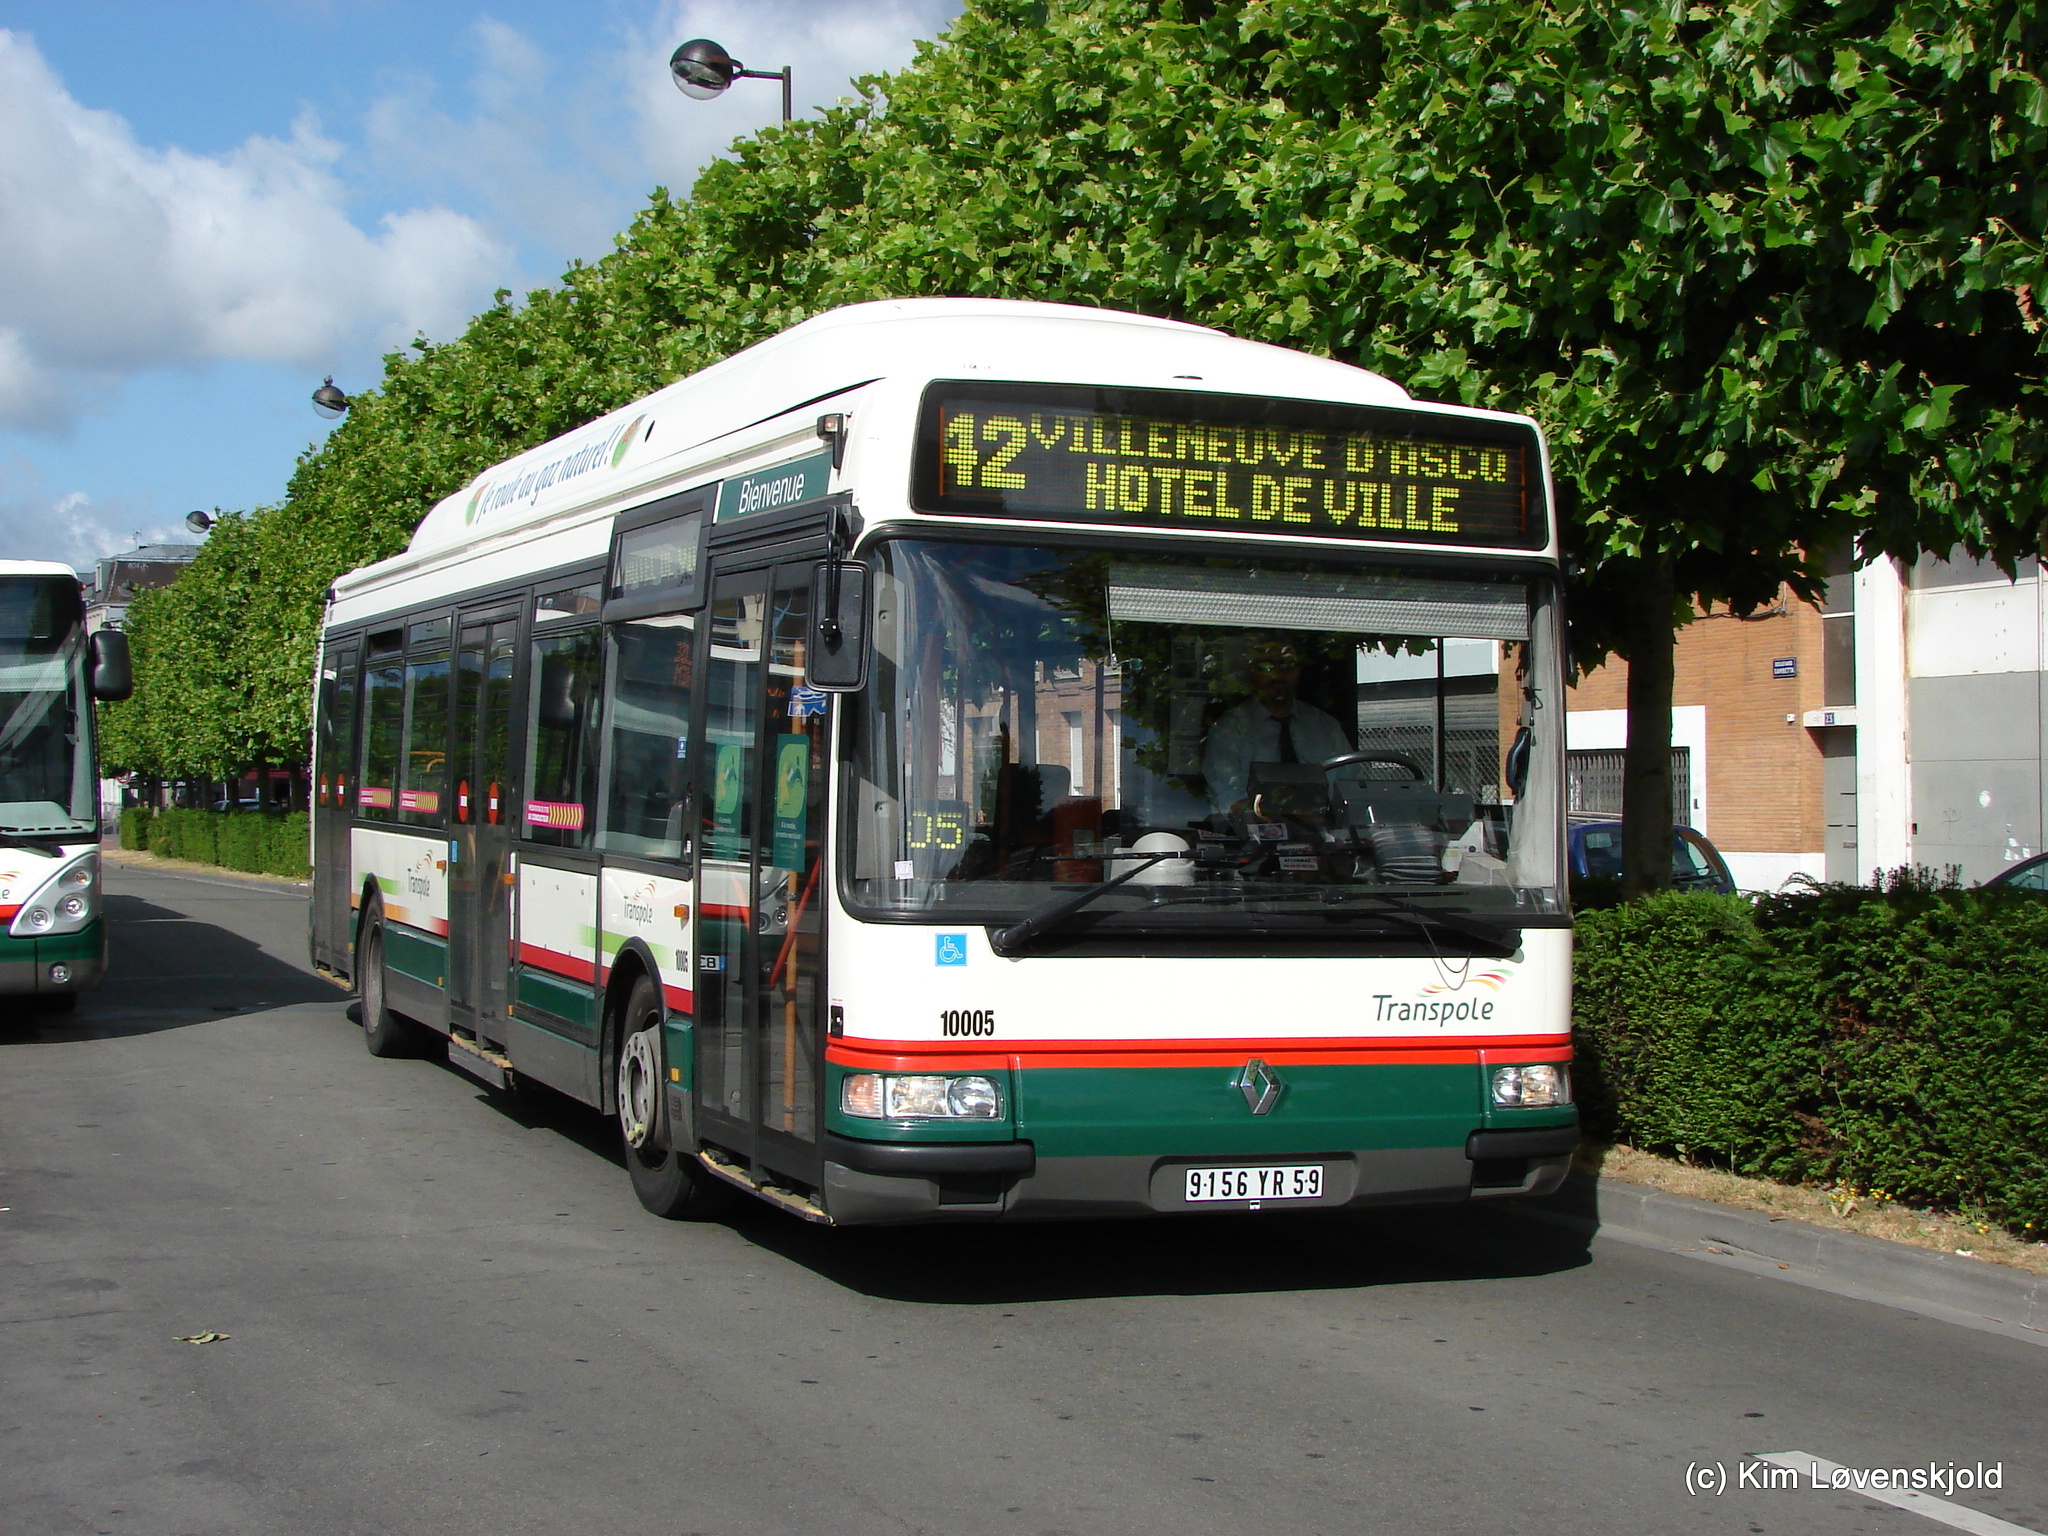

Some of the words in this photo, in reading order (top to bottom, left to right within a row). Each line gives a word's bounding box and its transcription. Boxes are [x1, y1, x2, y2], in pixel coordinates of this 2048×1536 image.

[943, 412, 1028, 490] 42
[1030, 412, 1326, 470] VILLENEUVE
[1346, 436, 1507, 483] D'ASCQ
[489, 467, 526, 512] roule
[517, 470, 539, 501] au
[530, 459, 562, 507] gaz
[738, 473, 805, 514] Bienvenue
[1085, 462, 1240, 518] HOTEL
[1252, 473, 1313, 524] DE
[1323, 478, 1460, 533] VILLE
[408, 868, 430, 901] Transpole
[623, 895, 654, 927] Transpole
[940, 1009, 995, 1037] 10005
[1372, 994, 1495, 1028] Transpole
[1189, 1170, 1248, 1198] 9156
[1258, 1169, 1284, 1196] YR
[1293, 1168, 1319, 1195] 59
